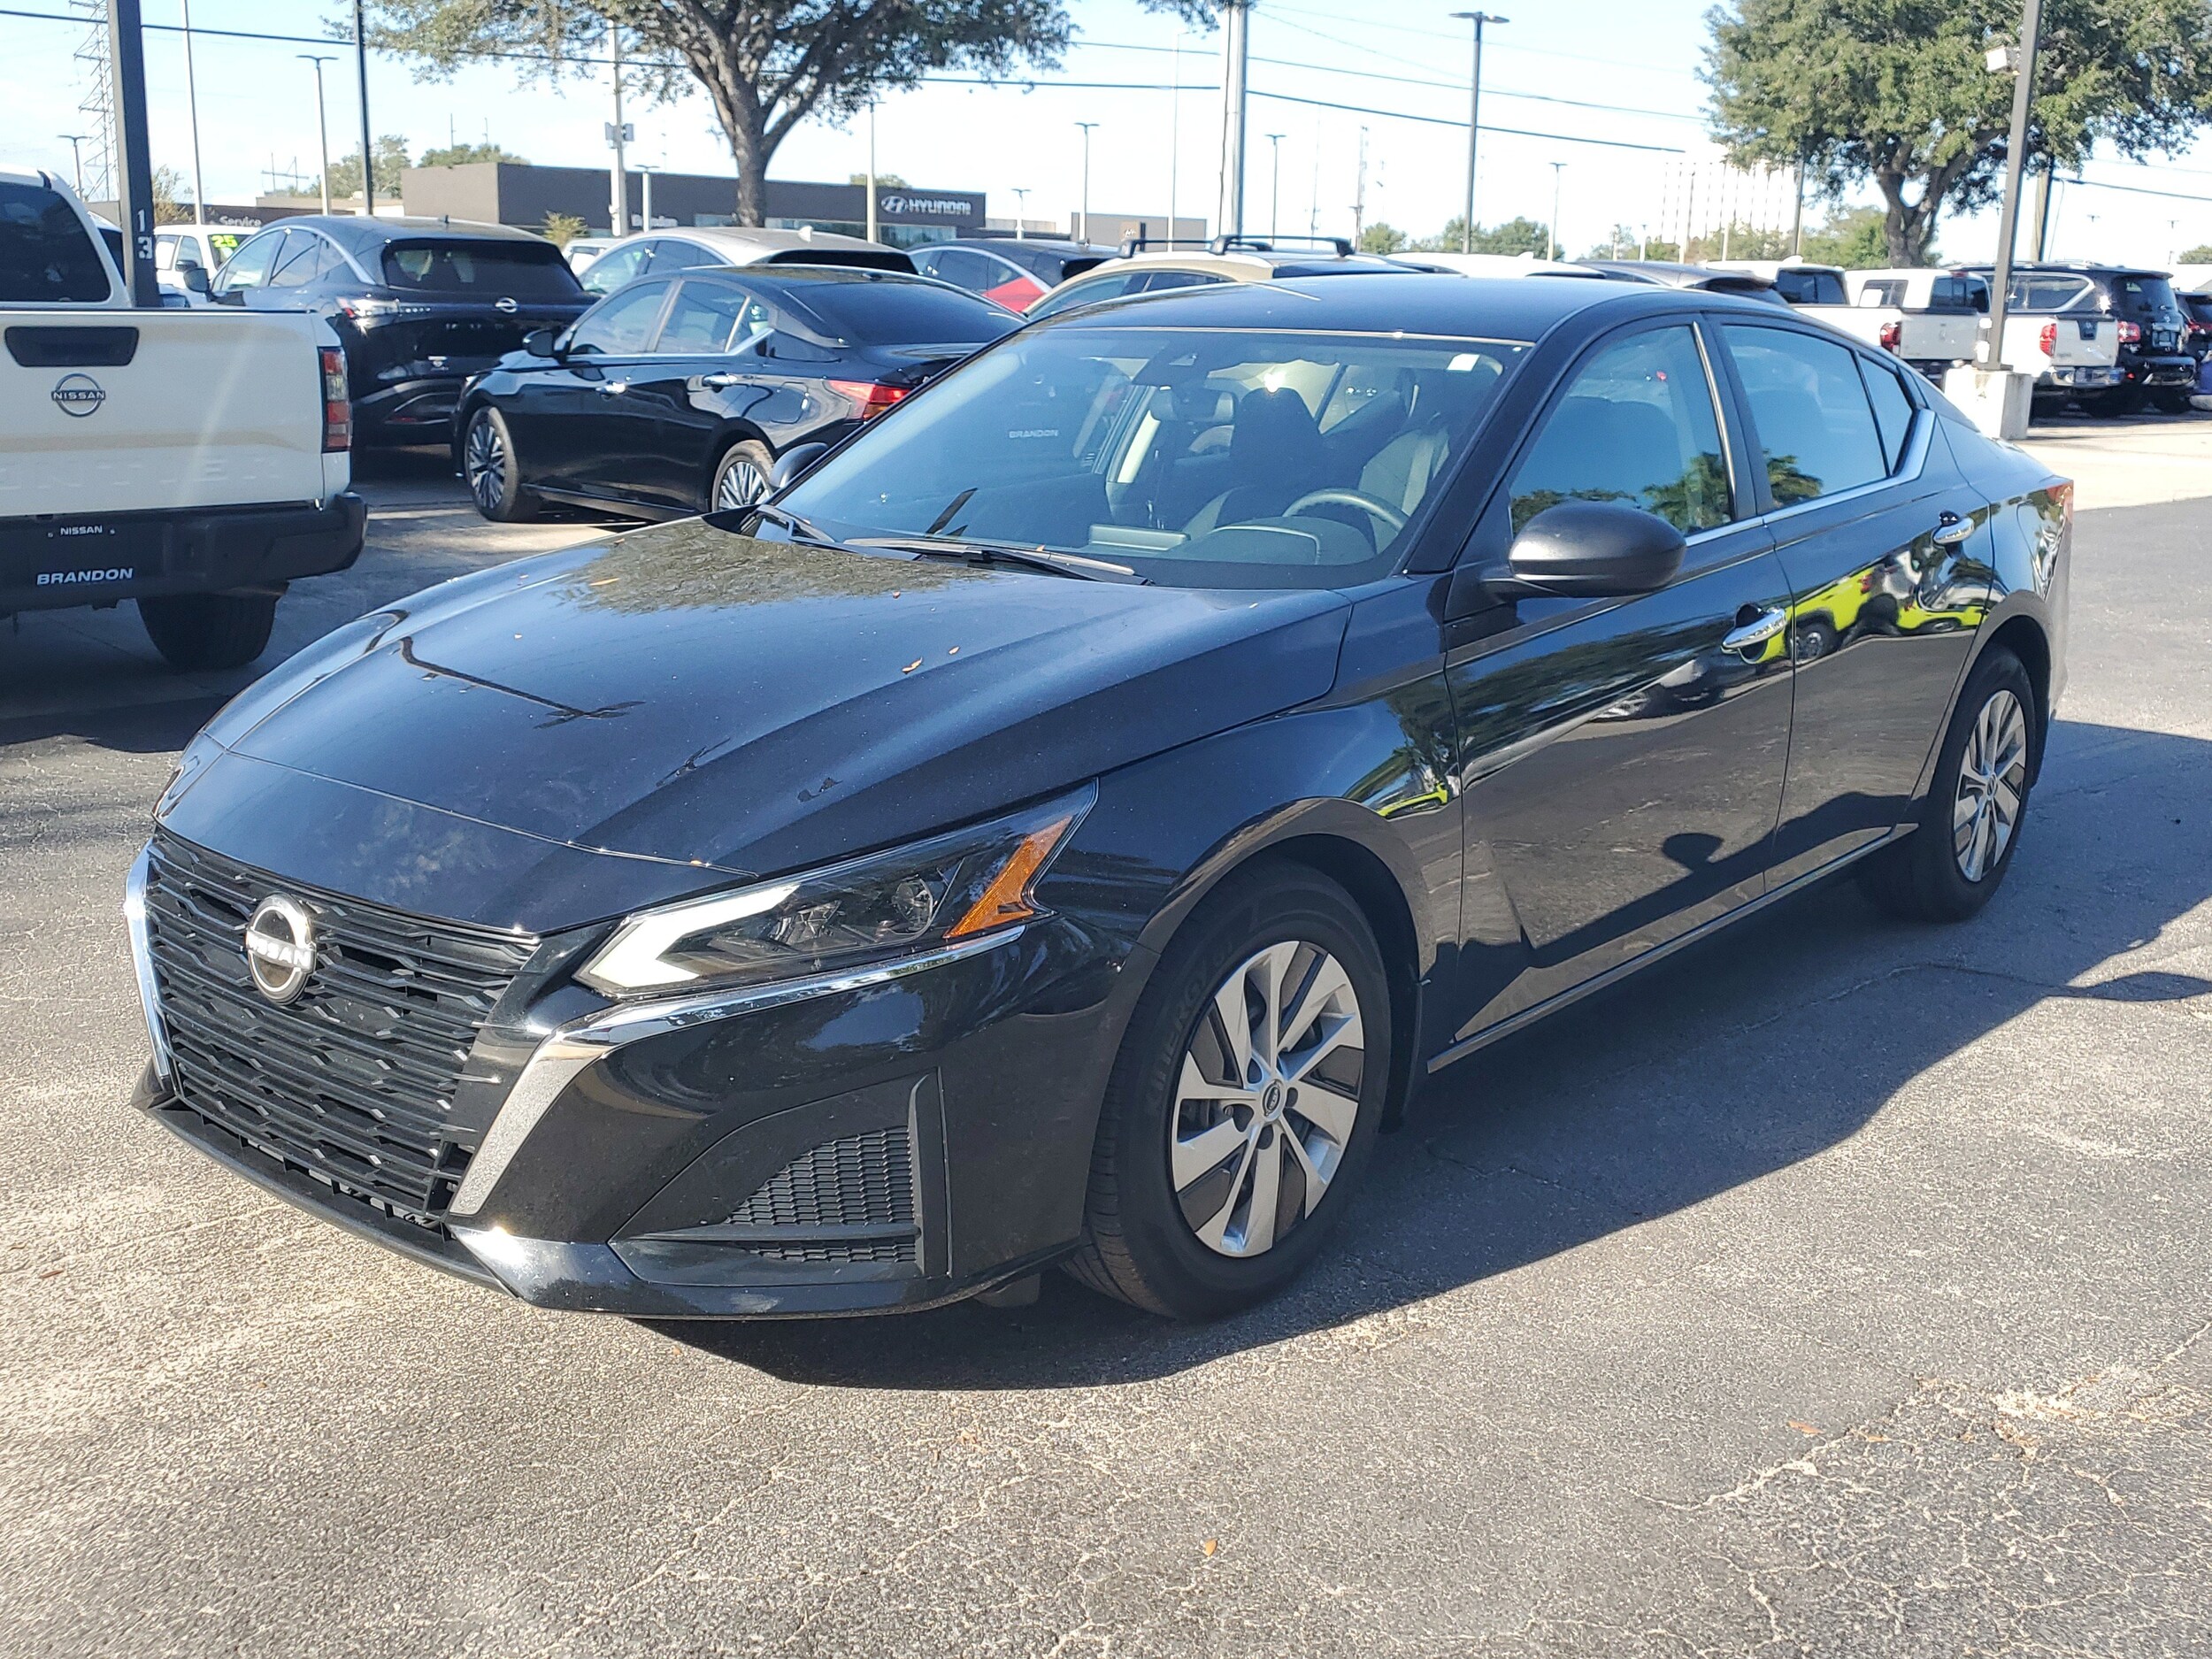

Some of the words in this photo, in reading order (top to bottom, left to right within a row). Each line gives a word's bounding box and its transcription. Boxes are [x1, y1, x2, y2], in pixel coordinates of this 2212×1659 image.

[908, 198, 972, 215] HYUNDAI
[219, 215, 262, 227] Service
[211, 234, 239, 249] 25
[53, 391, 104, 400] NISSAN
[60, 525, 104, 535] NISSAN
[36, 567, 134, 586] BRANDON
